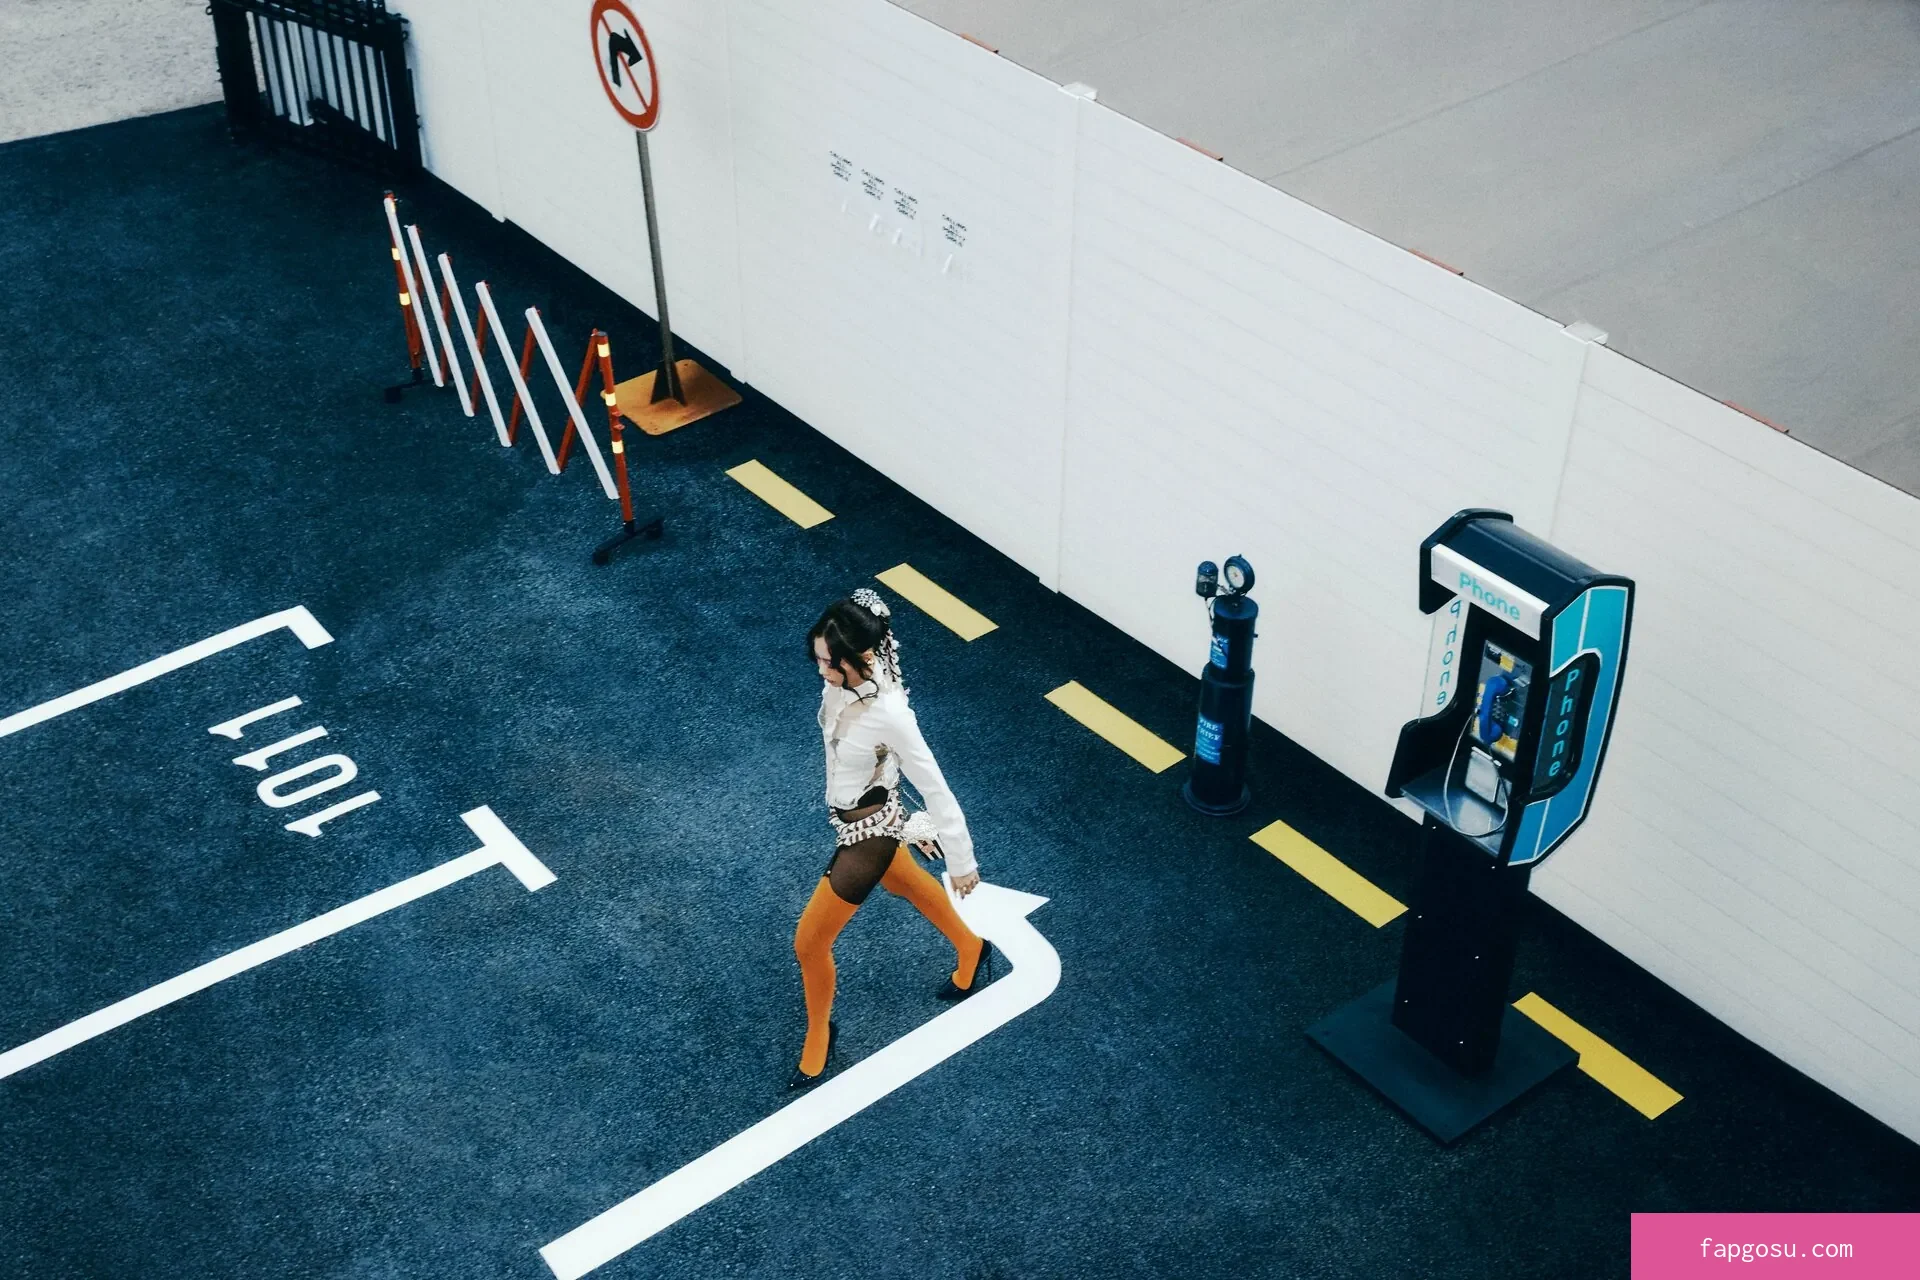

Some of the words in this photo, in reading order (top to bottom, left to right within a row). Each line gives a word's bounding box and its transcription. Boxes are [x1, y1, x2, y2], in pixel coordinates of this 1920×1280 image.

[1459, 571, 1520, 620] Phone
[207, 695, 382, 838] 1011
[1548, 668, 1580, 777] Phone
